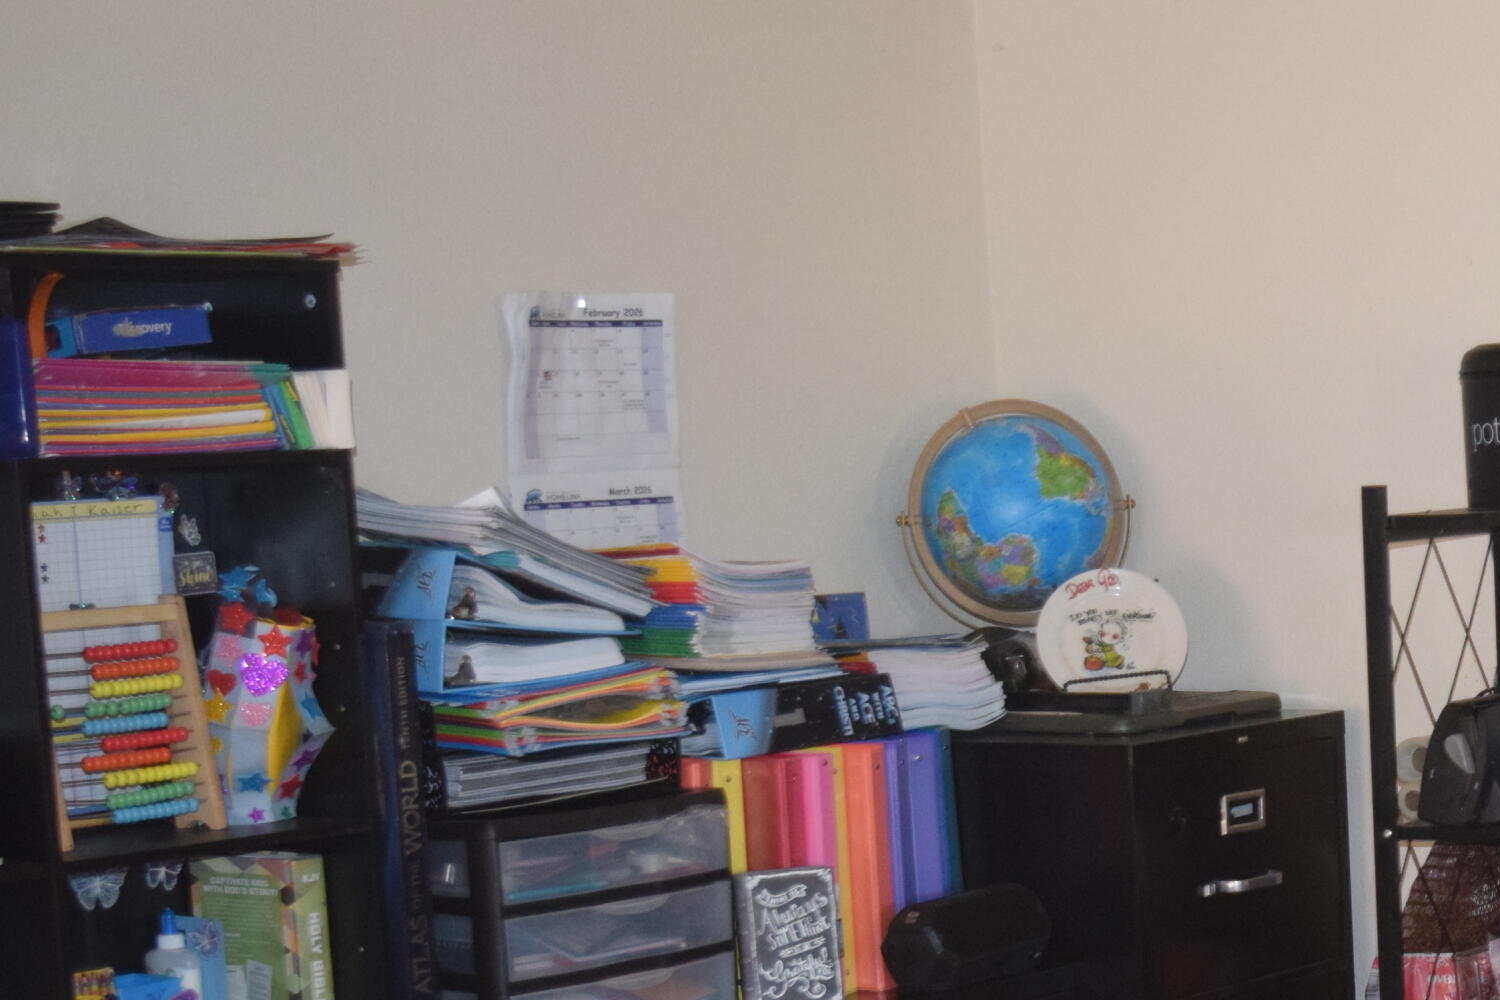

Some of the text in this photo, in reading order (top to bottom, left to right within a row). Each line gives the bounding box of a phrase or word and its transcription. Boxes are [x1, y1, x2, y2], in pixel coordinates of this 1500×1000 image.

[583, 308, 620, 318] February
[609, 487, 631, 496] March
[400, 760, 423, 856] WORLD
[309, 912, 323, 953] HOLY
